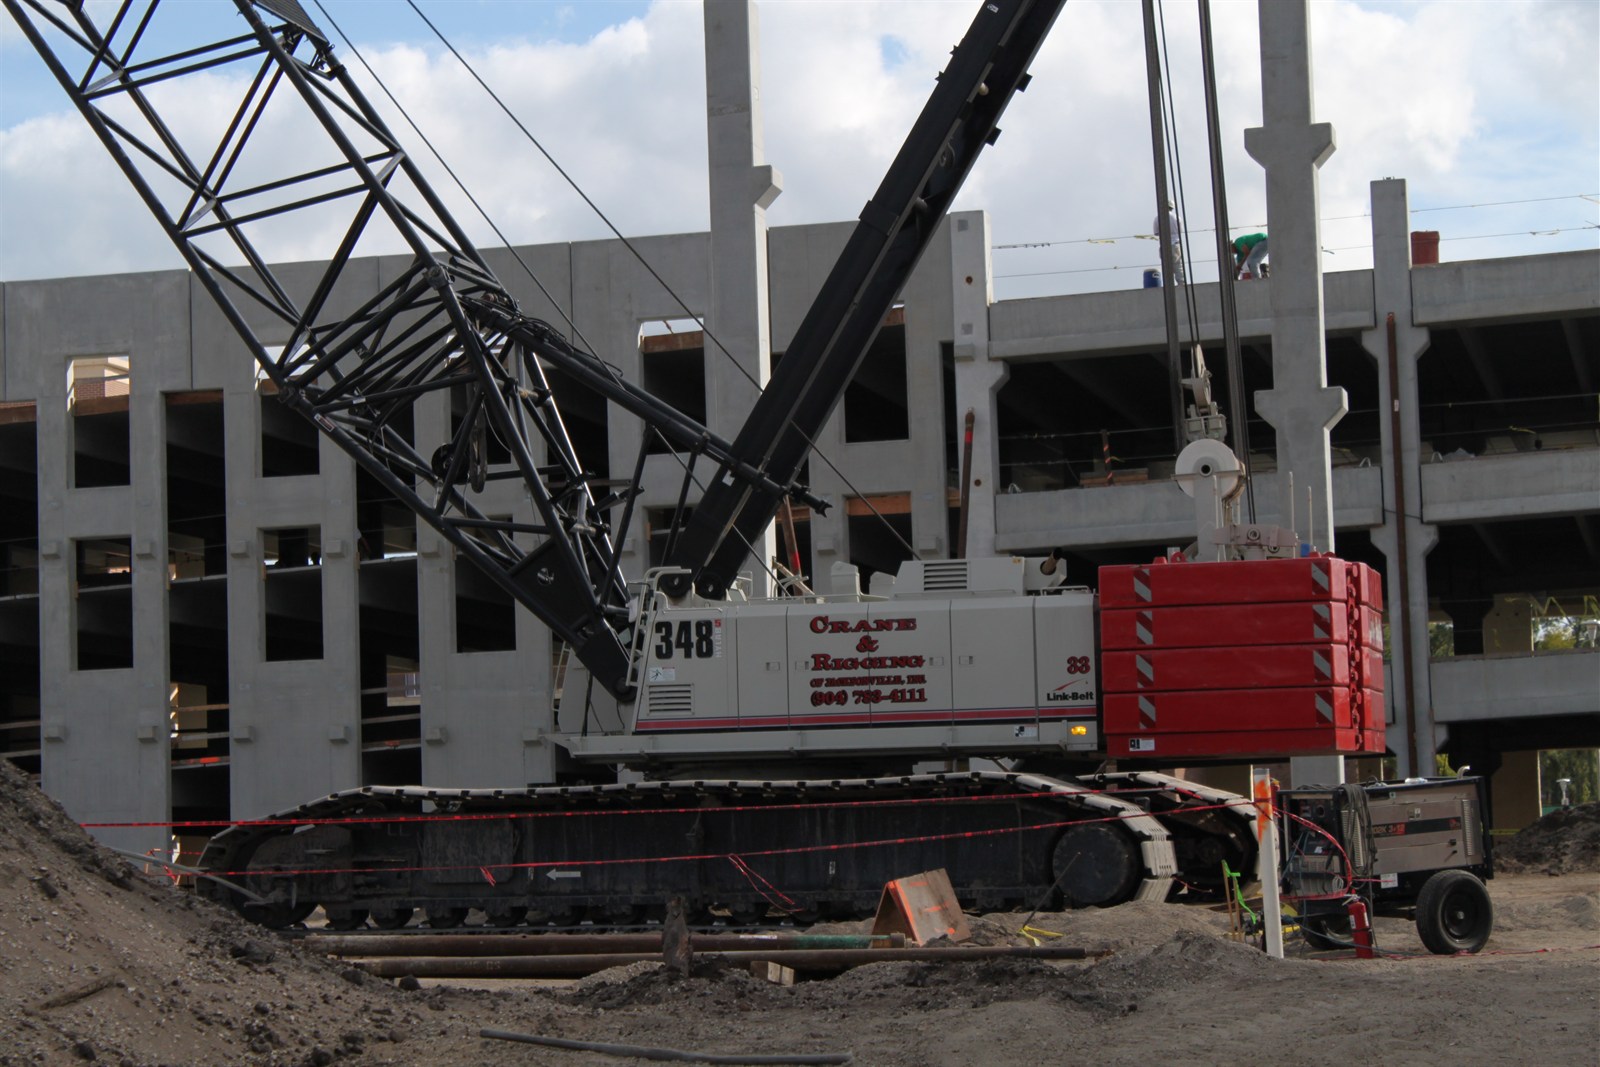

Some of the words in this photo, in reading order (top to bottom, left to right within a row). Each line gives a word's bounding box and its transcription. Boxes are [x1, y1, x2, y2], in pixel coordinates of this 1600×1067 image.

[810, 616, 917, 633] CRANE
[655, 620, 713, 659] 348
[856, 635, 879, 652] &
[811, 654, 925, 671] RIGGING
[1067, 656, 1091, 674] 33
[811, 690, 848, 707] (904)
[1047, 691, 1094, 701] Link-Belt
